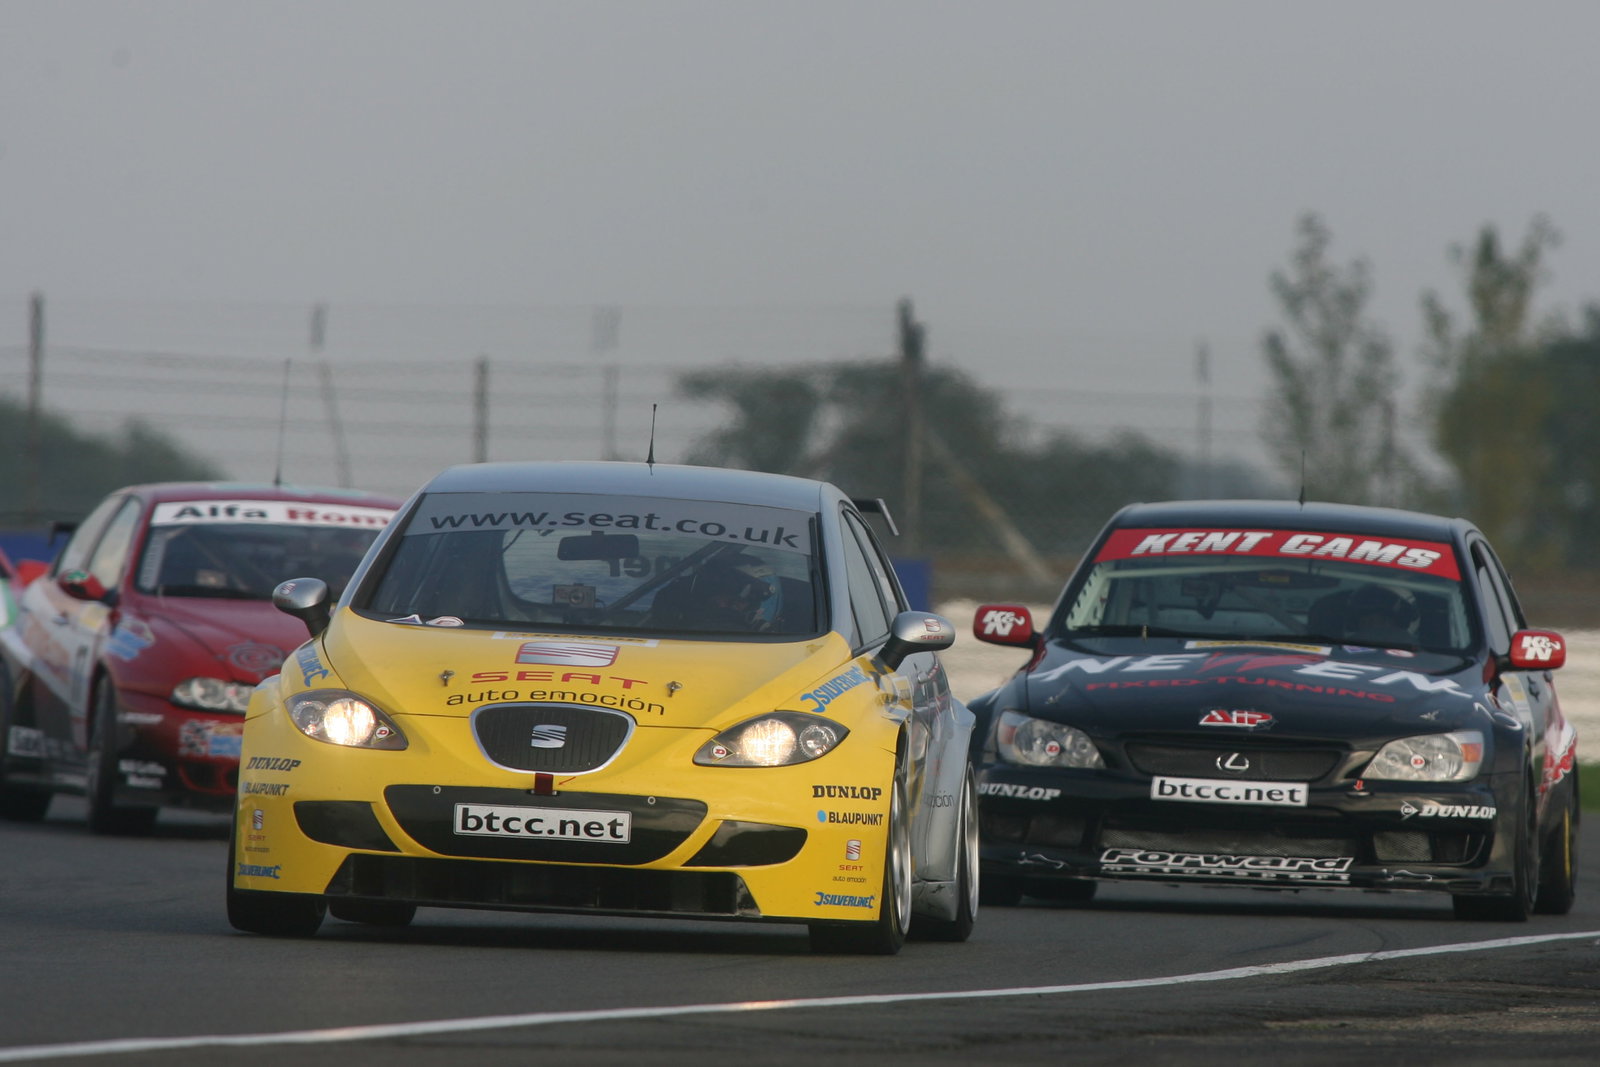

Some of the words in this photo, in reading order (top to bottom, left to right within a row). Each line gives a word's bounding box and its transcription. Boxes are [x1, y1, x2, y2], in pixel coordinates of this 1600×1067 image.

[173, 505, 268, 519] Alfa
[430, 510, 801, 549] www.seat.co.uk
[1131, 531, 1274, 555] KENT
[1279, 534, 1441, 568] CAMS
[471, 671, 648, 689] SEAT
[446, 689, 519, 706] auto
[529, 690, 665, 715] emoción
[246, 756, 301, 772] DUNLOP
[812, 785, 882, 800] DUNLOP
[977, 782, 1061, 800] DUNLOP
[1158, 779, 1303, 803] btcc.net
[828, 811, 883, 826] BLAUPUNKT
[1418, 804, 1497, 819] DUNLOP
[461, 807, 625, 839] btcc.net
[839, 864, 864, 872] SEAT
[1100, 848, 1354, 872] Forward
[816, 892, 874, 908] SILVERLINE
